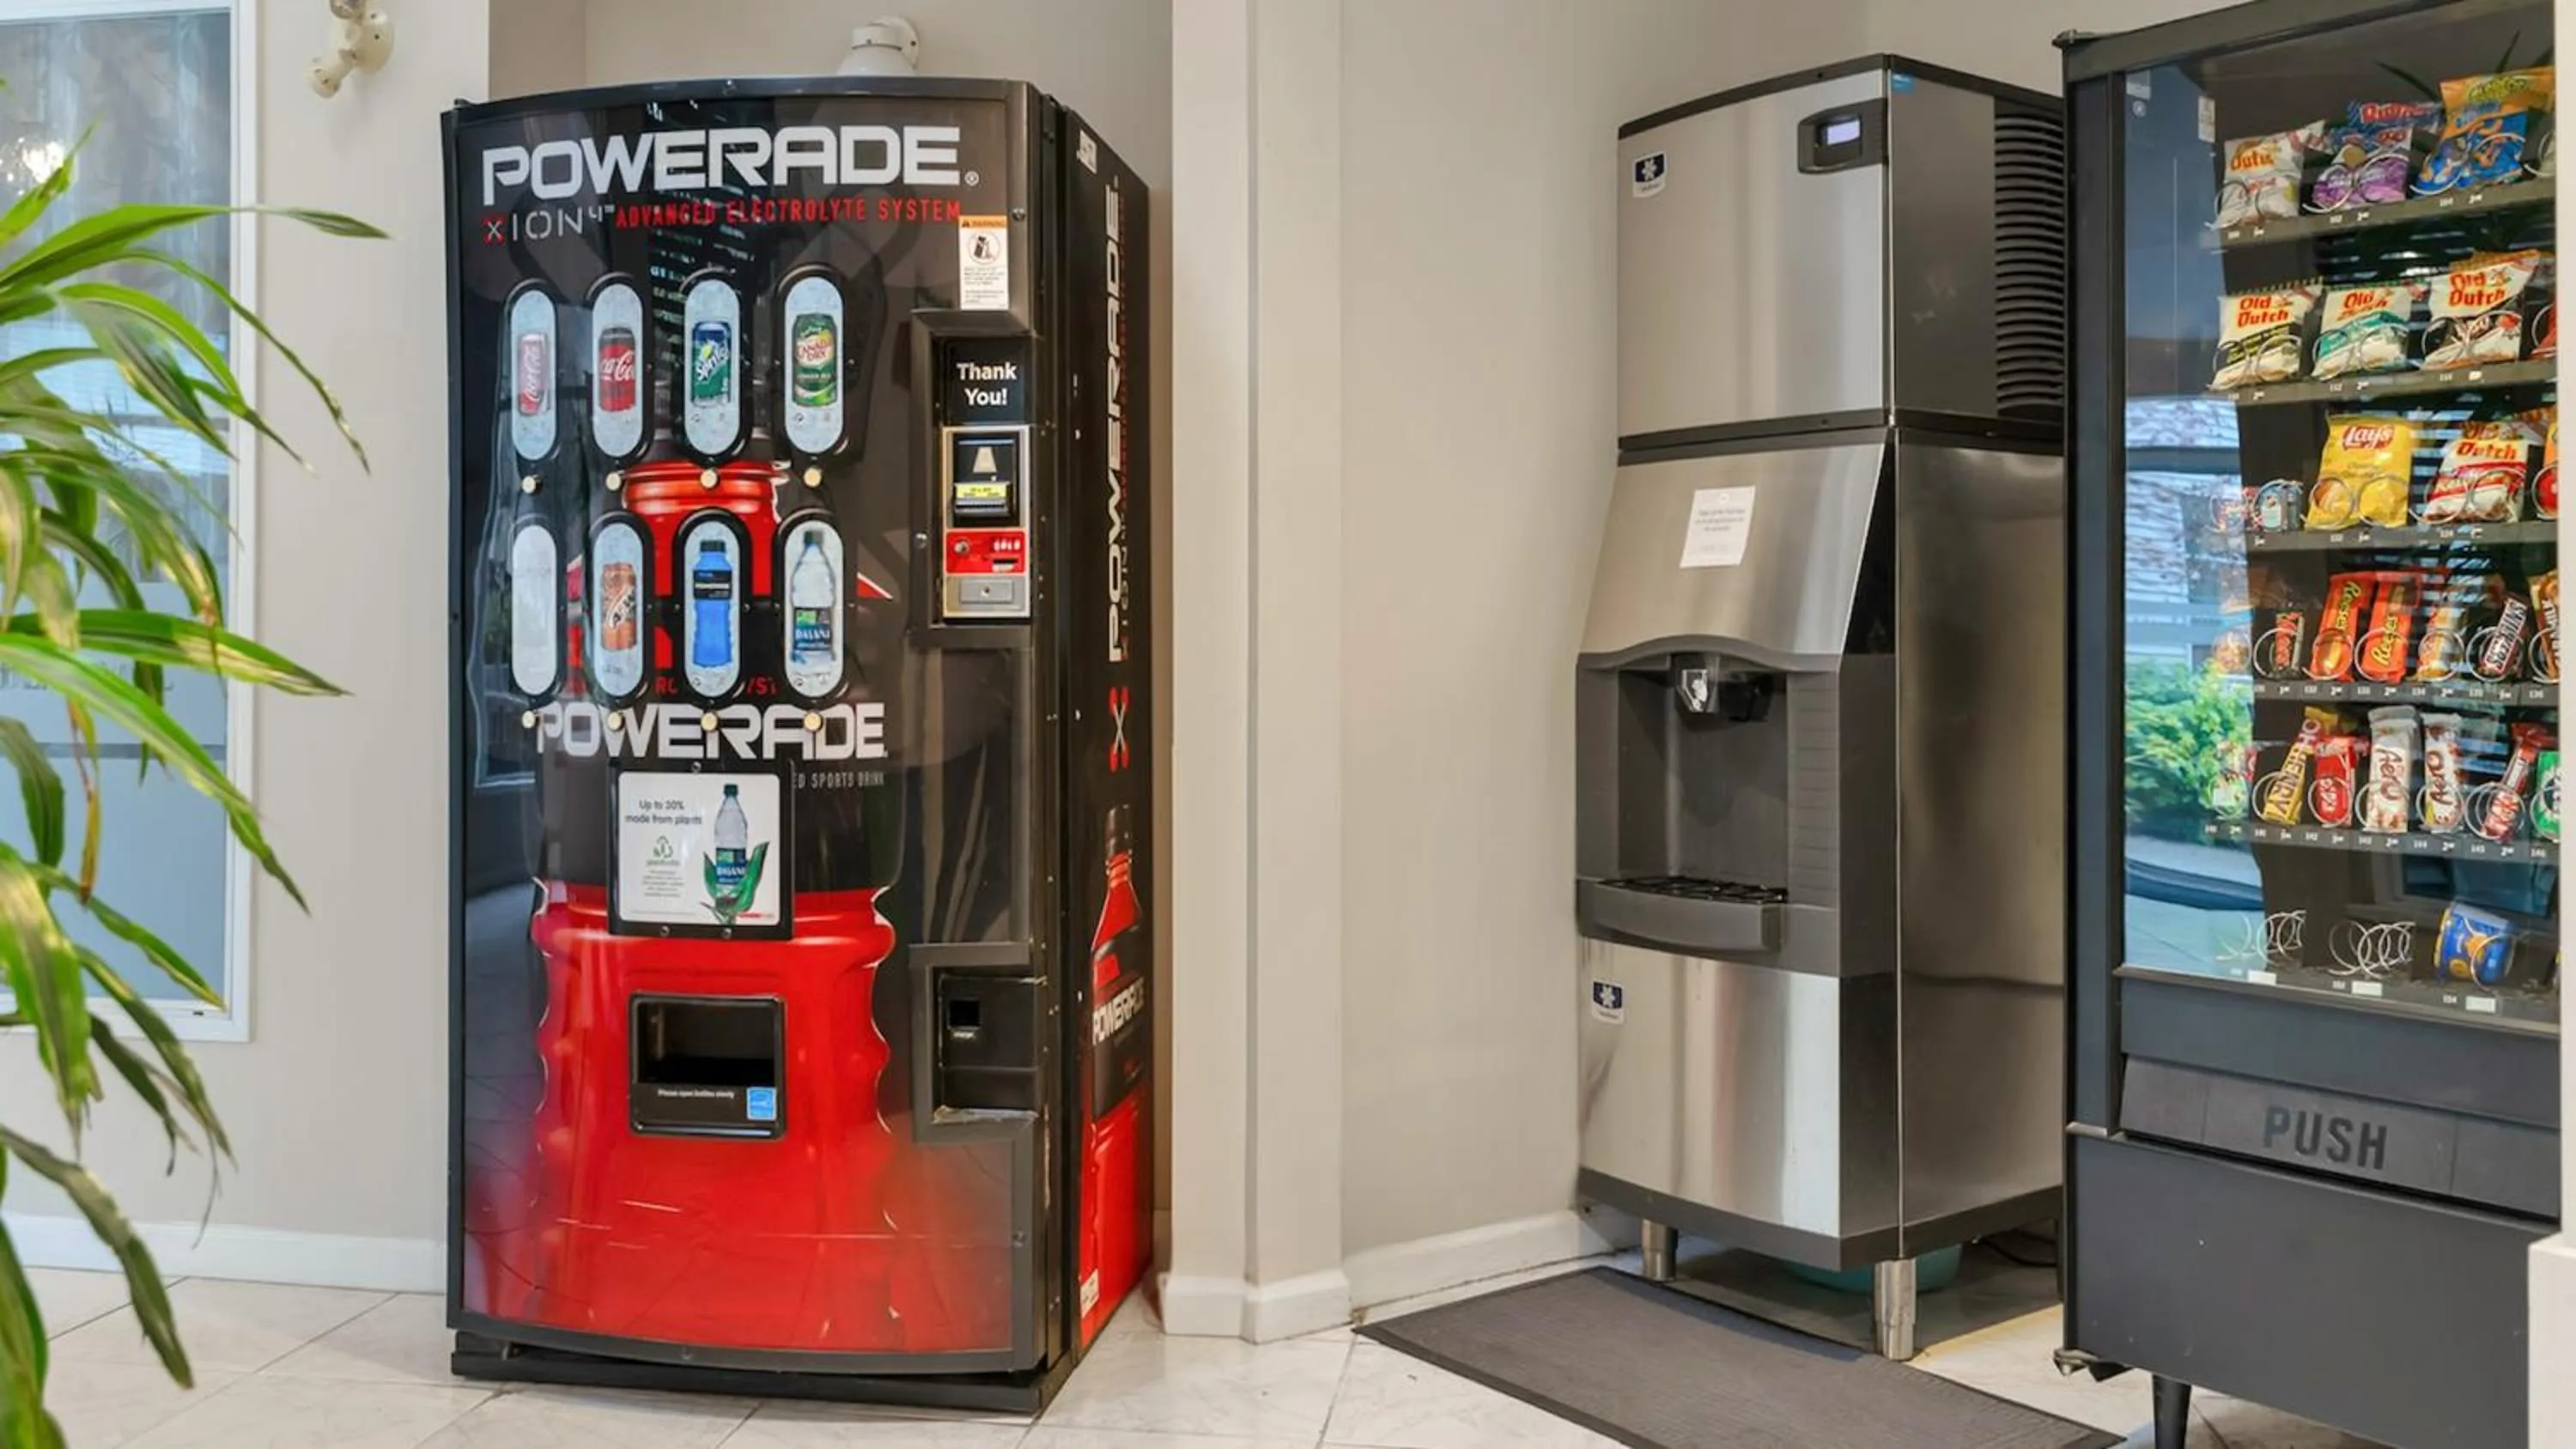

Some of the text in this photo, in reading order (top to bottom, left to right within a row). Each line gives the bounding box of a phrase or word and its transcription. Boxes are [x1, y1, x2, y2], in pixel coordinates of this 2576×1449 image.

[483, 126, 961, 206] POWERADE
[615, 203, 715, 229] ADVANCED
[726, 196, 866, 224] ELECTROLYTE
[878, 197, 961, 222] SYSTEM
[2239, 295, 2271, 310] Old
[2237, 309, 2289, 329] Dutch
[956, 361, 1018, 380] Thank
[964, 387, 1009, 406] You!
[1105, 182, 1121, 662] POWERADE
[534, 702, 885, 760] POWERADE
[811, 772, 854, 789] SPORTS
[638, 800, 653, 811] Up
[653, 800, 664, 810] to
[625, 814, 650, 825] made
[652, 814, 673, 825] from
[2263, 1105, 2387, 1171] PUSH
